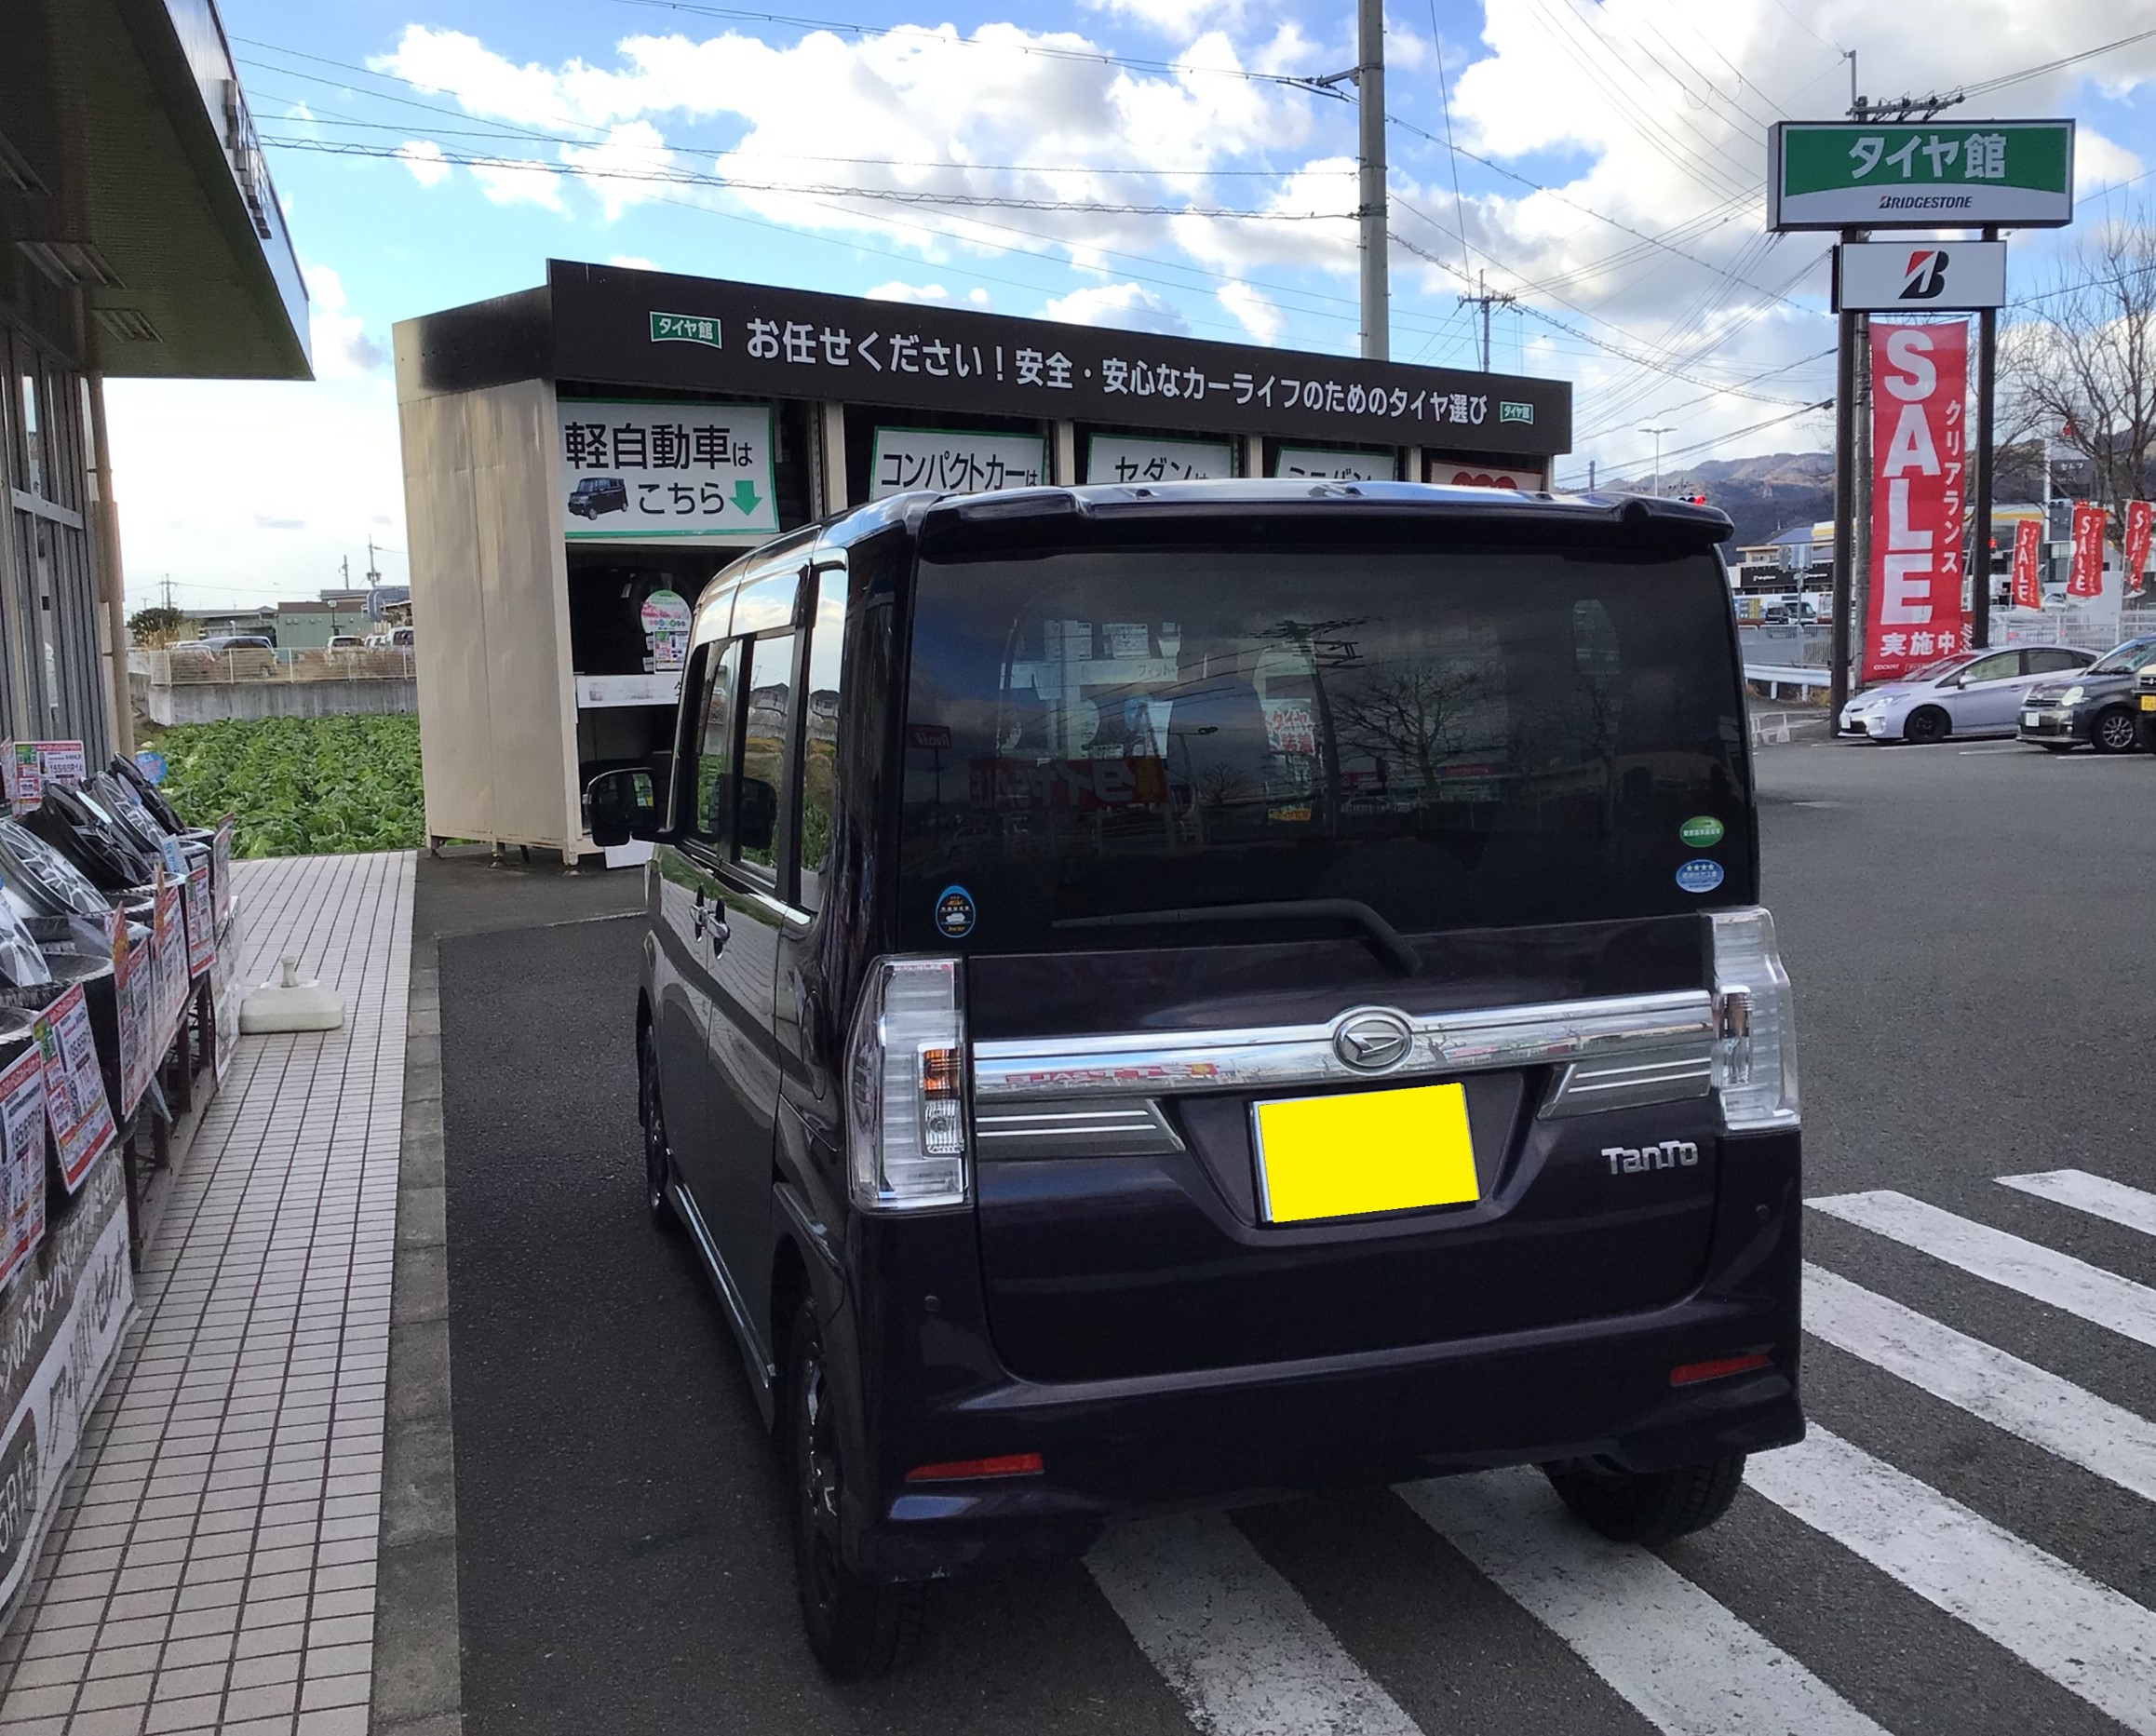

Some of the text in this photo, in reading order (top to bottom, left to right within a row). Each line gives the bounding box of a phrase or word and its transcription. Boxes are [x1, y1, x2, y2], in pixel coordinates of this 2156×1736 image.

[1848, 133, 2007, 179] タイヤ館
[1879, 195, 1973, 209] BRIDGESTONE
[658, 316, 714, 341] タイヤ館
[1504, 405, 1530, 419] タイヤ館
[565, 422, 753, 471] 軽自動車は
[1880, 330, 1941, 625] SALE
[1941, 399, 1962, 573] クリアランス
[639, 481, 725, 516] こちら
[2017, 528, 2029, 602] SALE
[1880, 630, 1956, 657] 実施中
